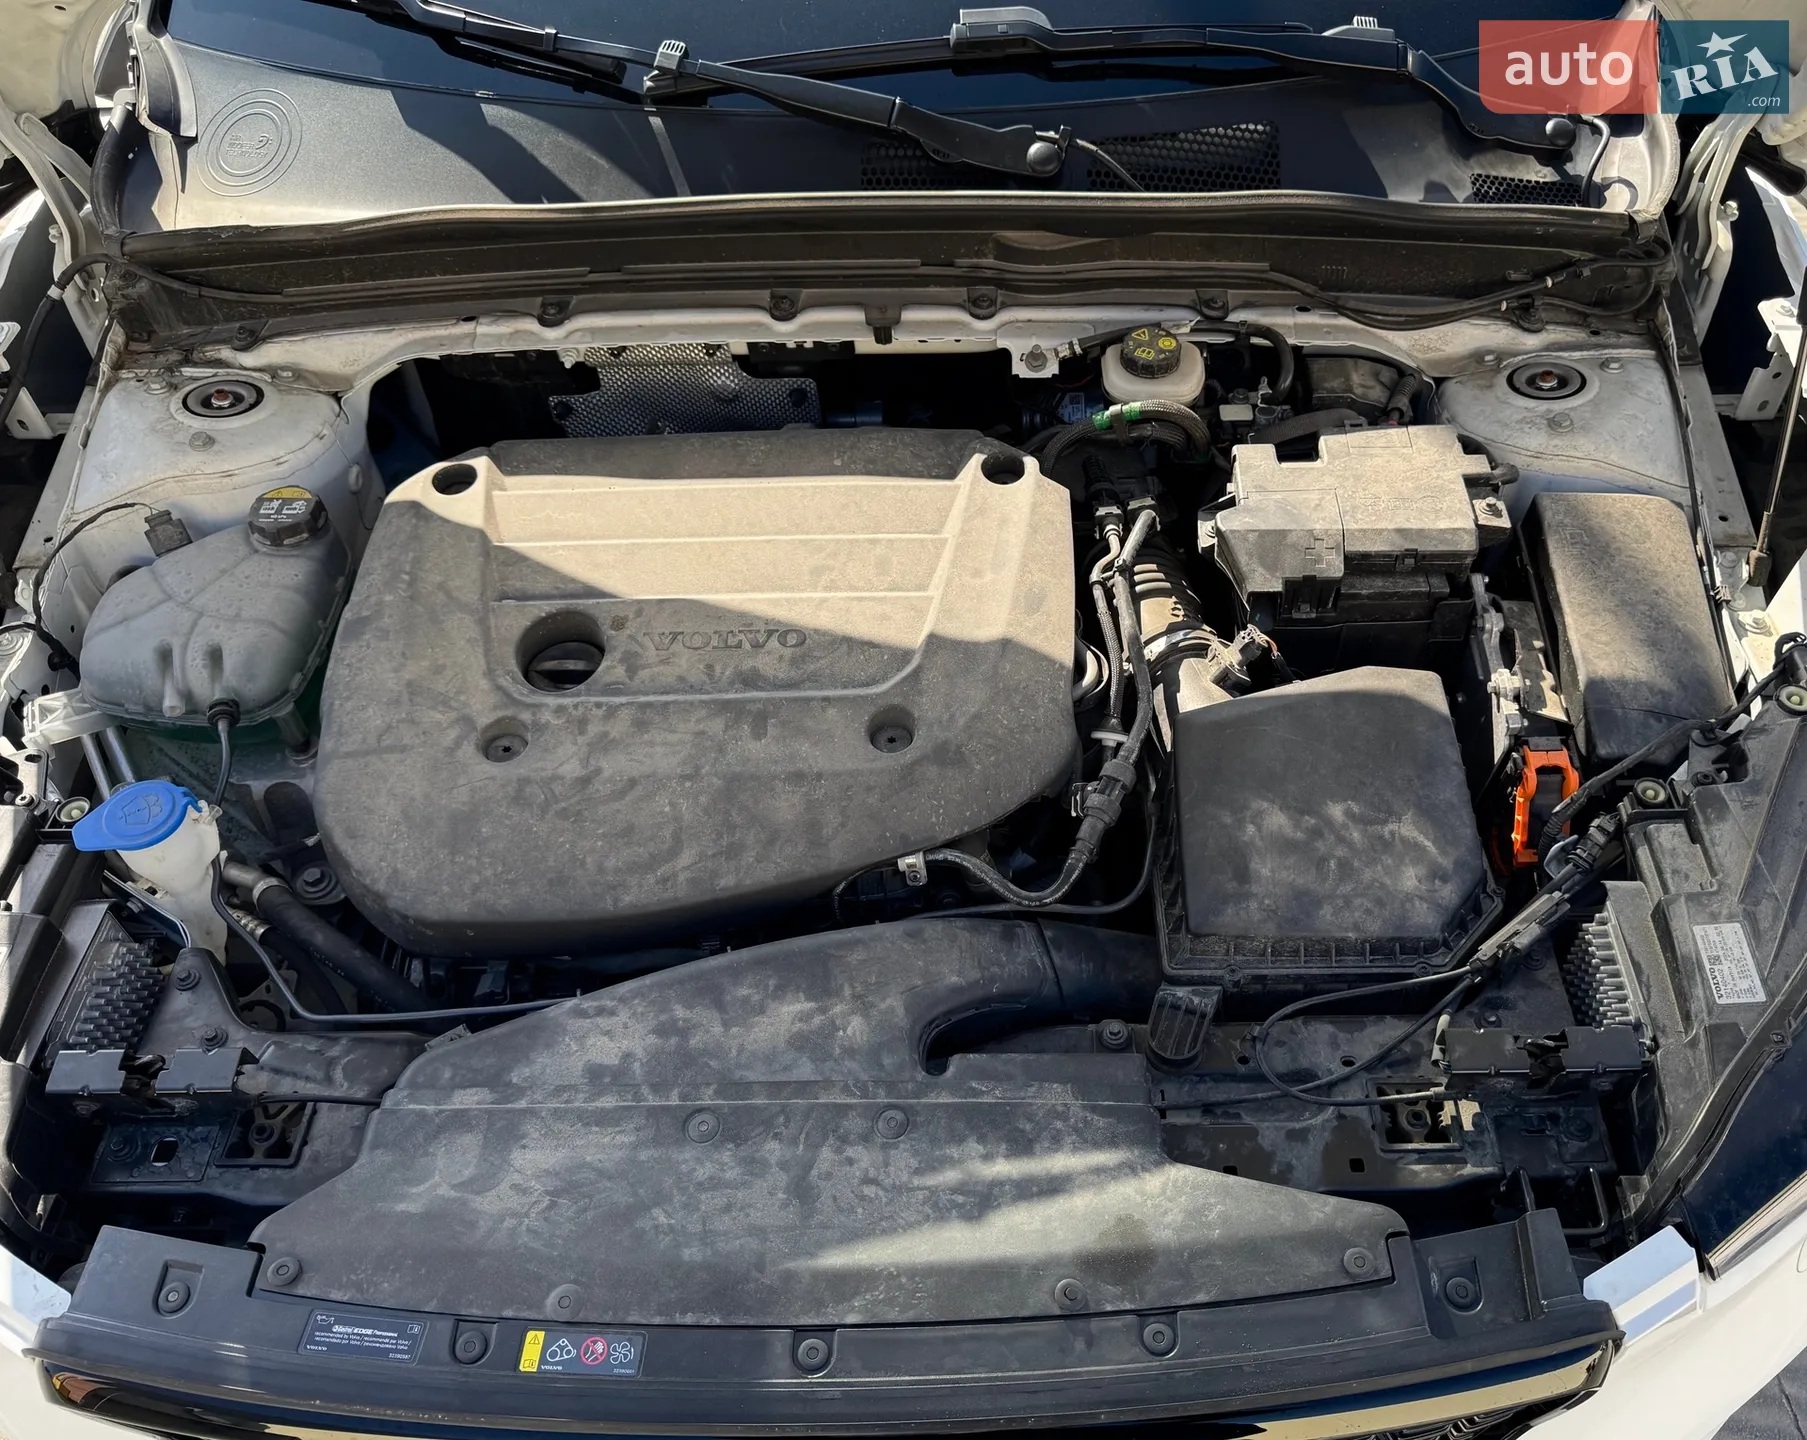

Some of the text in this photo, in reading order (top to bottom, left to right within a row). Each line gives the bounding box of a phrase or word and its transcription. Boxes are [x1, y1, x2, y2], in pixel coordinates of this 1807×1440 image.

[643, 628, 807, 650] VOLVO
[1708, 967, 1724, 999] VOLVO
[353, 1327, 374, 1335] EDGE
